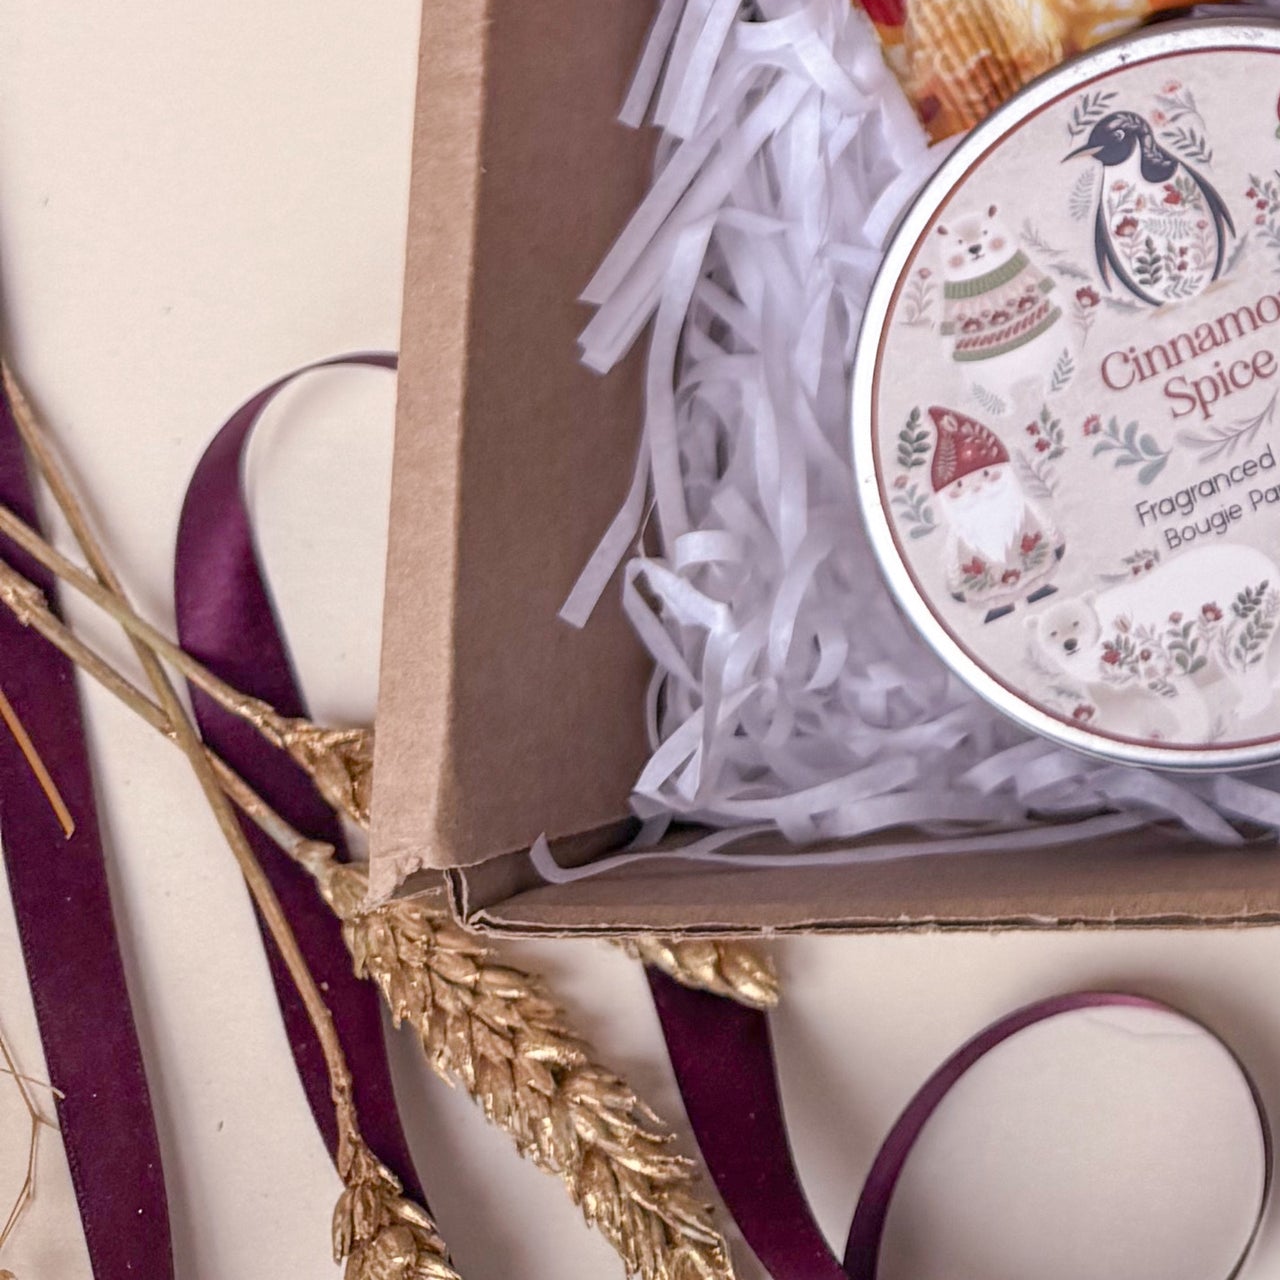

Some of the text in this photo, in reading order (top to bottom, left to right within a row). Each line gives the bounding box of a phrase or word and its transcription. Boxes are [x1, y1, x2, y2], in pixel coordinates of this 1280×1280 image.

[1162, 348, 1279, 420] Spice
[1134, 442, 1277, 528] Fragranced
[1164, 502, 1244, 551] Bougie
